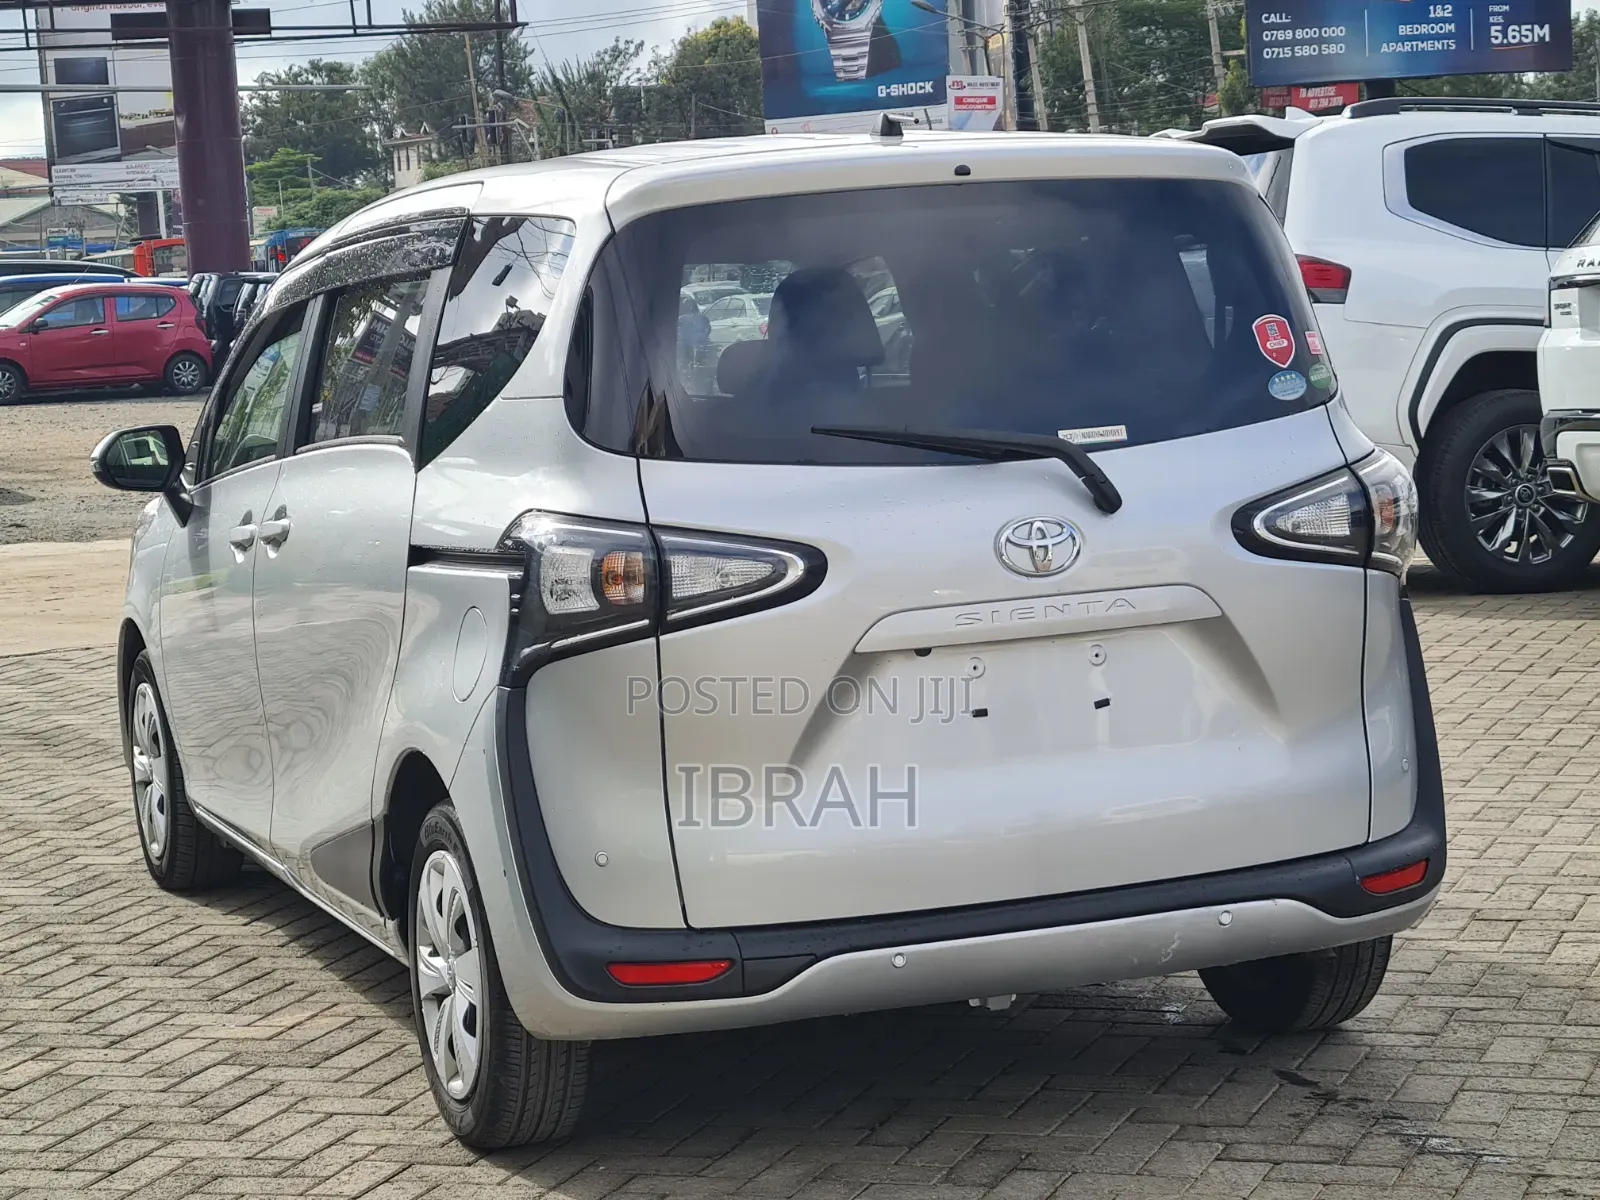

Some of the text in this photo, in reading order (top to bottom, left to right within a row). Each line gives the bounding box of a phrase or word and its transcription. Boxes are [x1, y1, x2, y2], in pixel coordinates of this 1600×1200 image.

[1262, 13, 1292, 24] CALL:
[1429, 5, 1453, 18] 1&2
[1263, 26, 1346, 41] 0769 800 000
[1399, 23, 1456, 36] BEDROOM
[1490, 24, 1550, 44] 5.65M
[1263, 43, 1346, 59] 0715 580 580
[1380, 40, 1456, 53] APARTMENTS
[878, 81, 934, 98] G-SHOCK
[1307, 86, 1337, 97] ADVERTISE
[955, 598, 1137, 628] SIENTA
